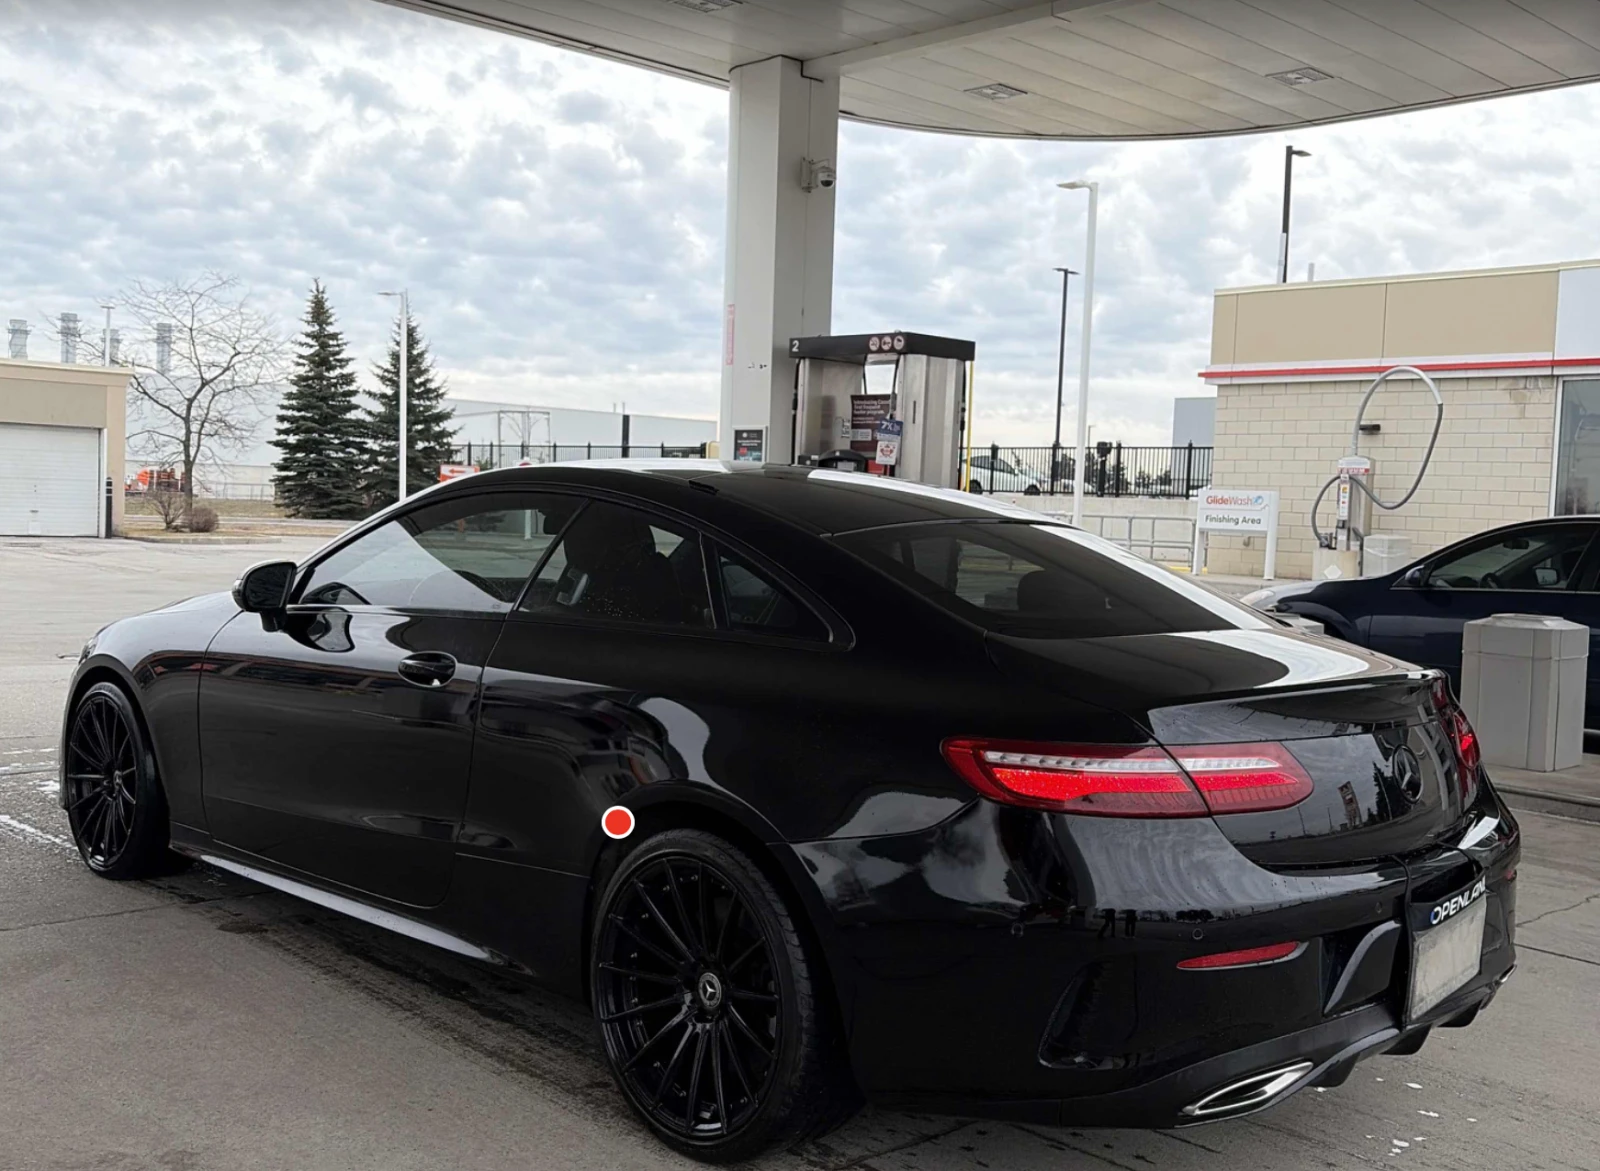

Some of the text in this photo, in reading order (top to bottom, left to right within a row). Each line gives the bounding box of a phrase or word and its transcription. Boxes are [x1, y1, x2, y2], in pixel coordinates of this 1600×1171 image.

[792, 339, 799, 352] 2
[1206, 495, 1253, 506] GlideWash
[1205, 515, 1262, 526] Finishing Area
